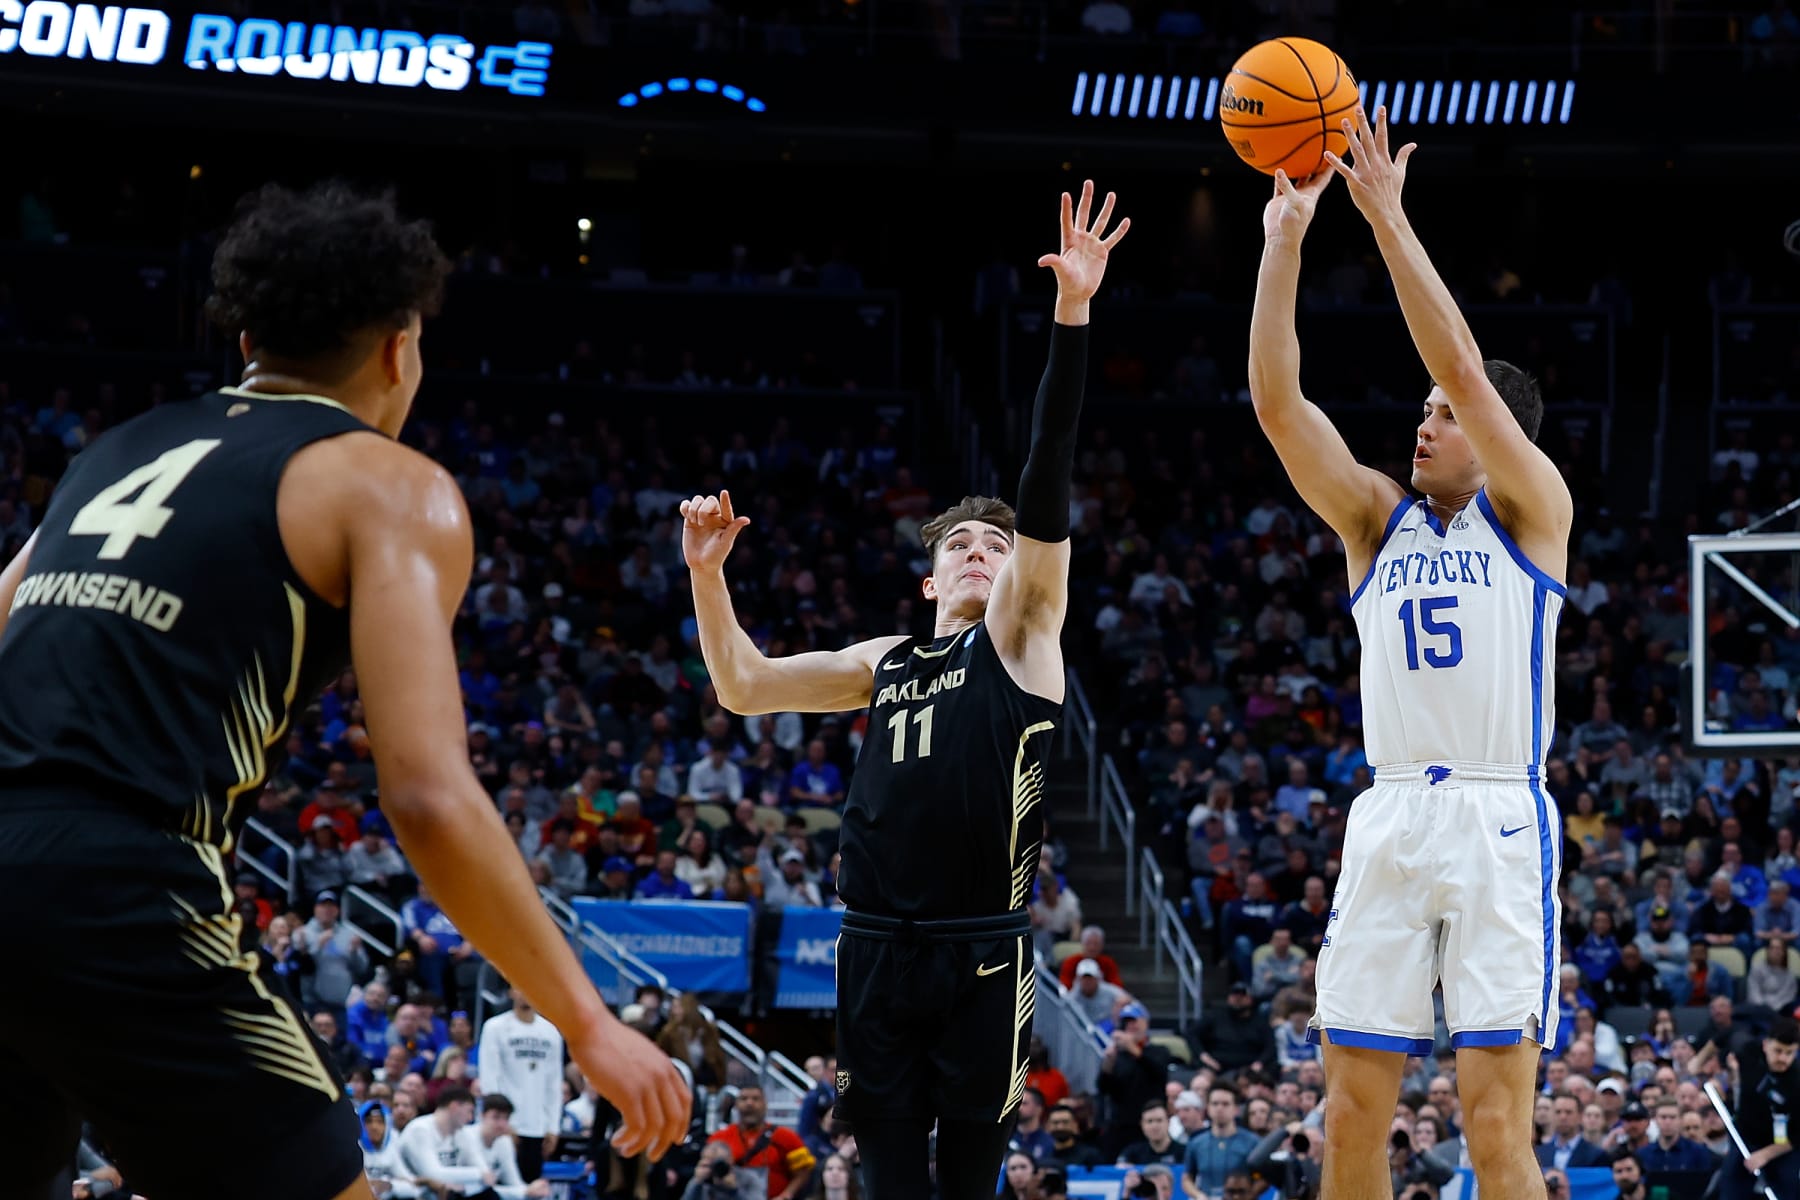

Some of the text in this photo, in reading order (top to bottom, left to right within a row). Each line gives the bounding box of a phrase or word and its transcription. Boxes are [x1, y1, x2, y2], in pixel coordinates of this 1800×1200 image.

[184, 13, 475, 90] ROUNDS
[68, 438, 222, 560] 4
[8, 572, 184, 632] OWNSEND
[1398, 595, 1464, 671] 15
[875, 667, 966, 708] OAKLAND
[887, 704, 935, 764] 11
